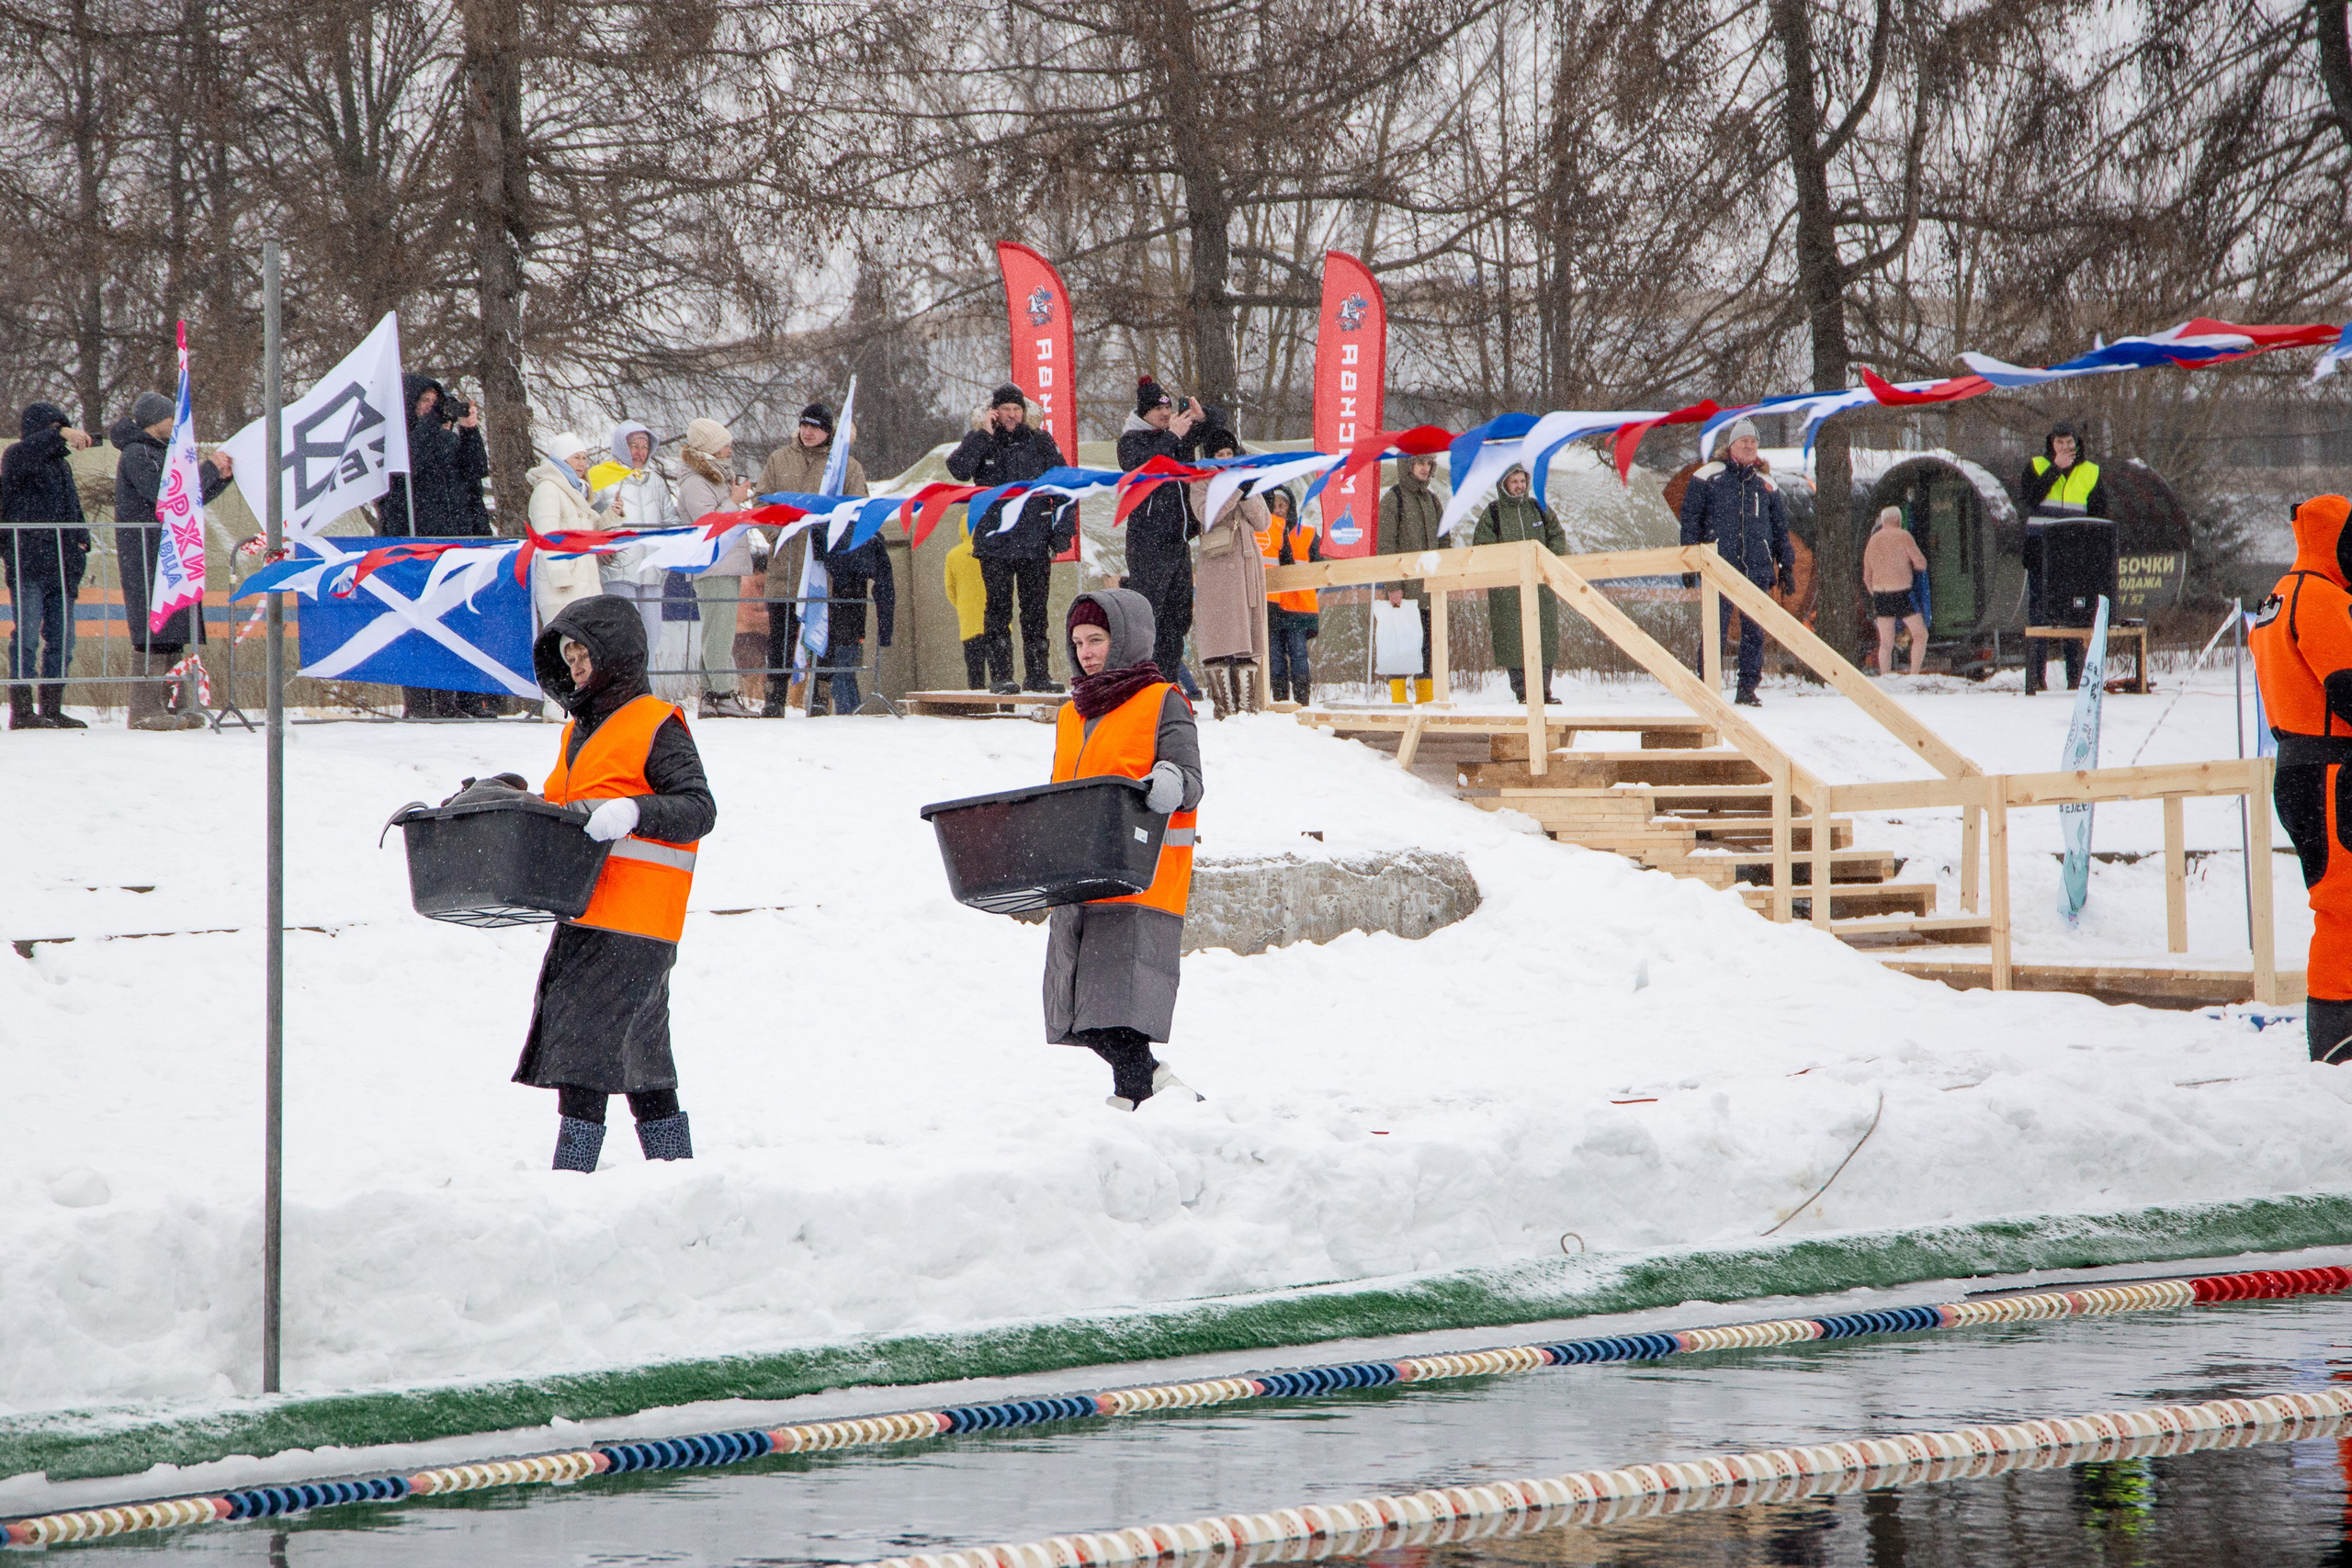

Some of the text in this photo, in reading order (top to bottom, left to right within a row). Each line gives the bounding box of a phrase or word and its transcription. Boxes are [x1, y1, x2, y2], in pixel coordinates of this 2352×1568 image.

[1339, 344, 1359, 494] МСКВА
[2119, 556, 2175, 575] БОЧКИ
[2119, 576, 2162, 591] ОДАЖА
